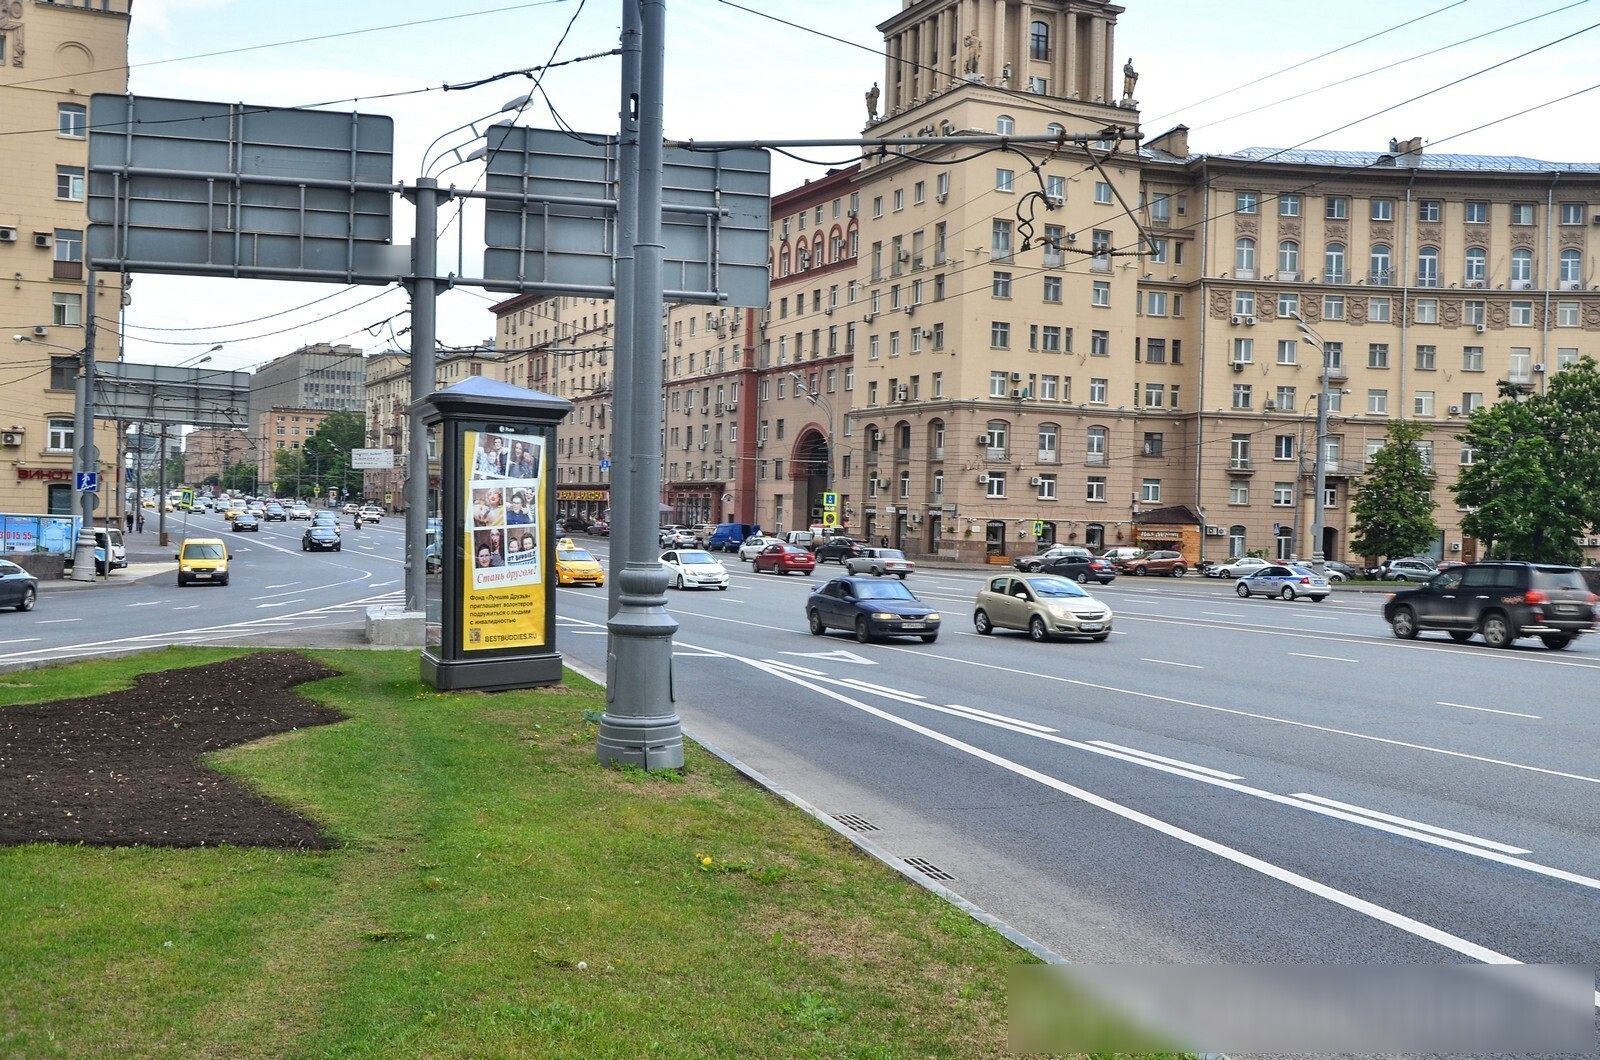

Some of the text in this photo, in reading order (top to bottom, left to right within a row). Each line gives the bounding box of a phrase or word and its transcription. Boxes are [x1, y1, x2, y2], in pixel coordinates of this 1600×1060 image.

[477, 566, 537, 583] Стань другом!
[484, 633, 537, 642] BESTBUDDIES.RU
